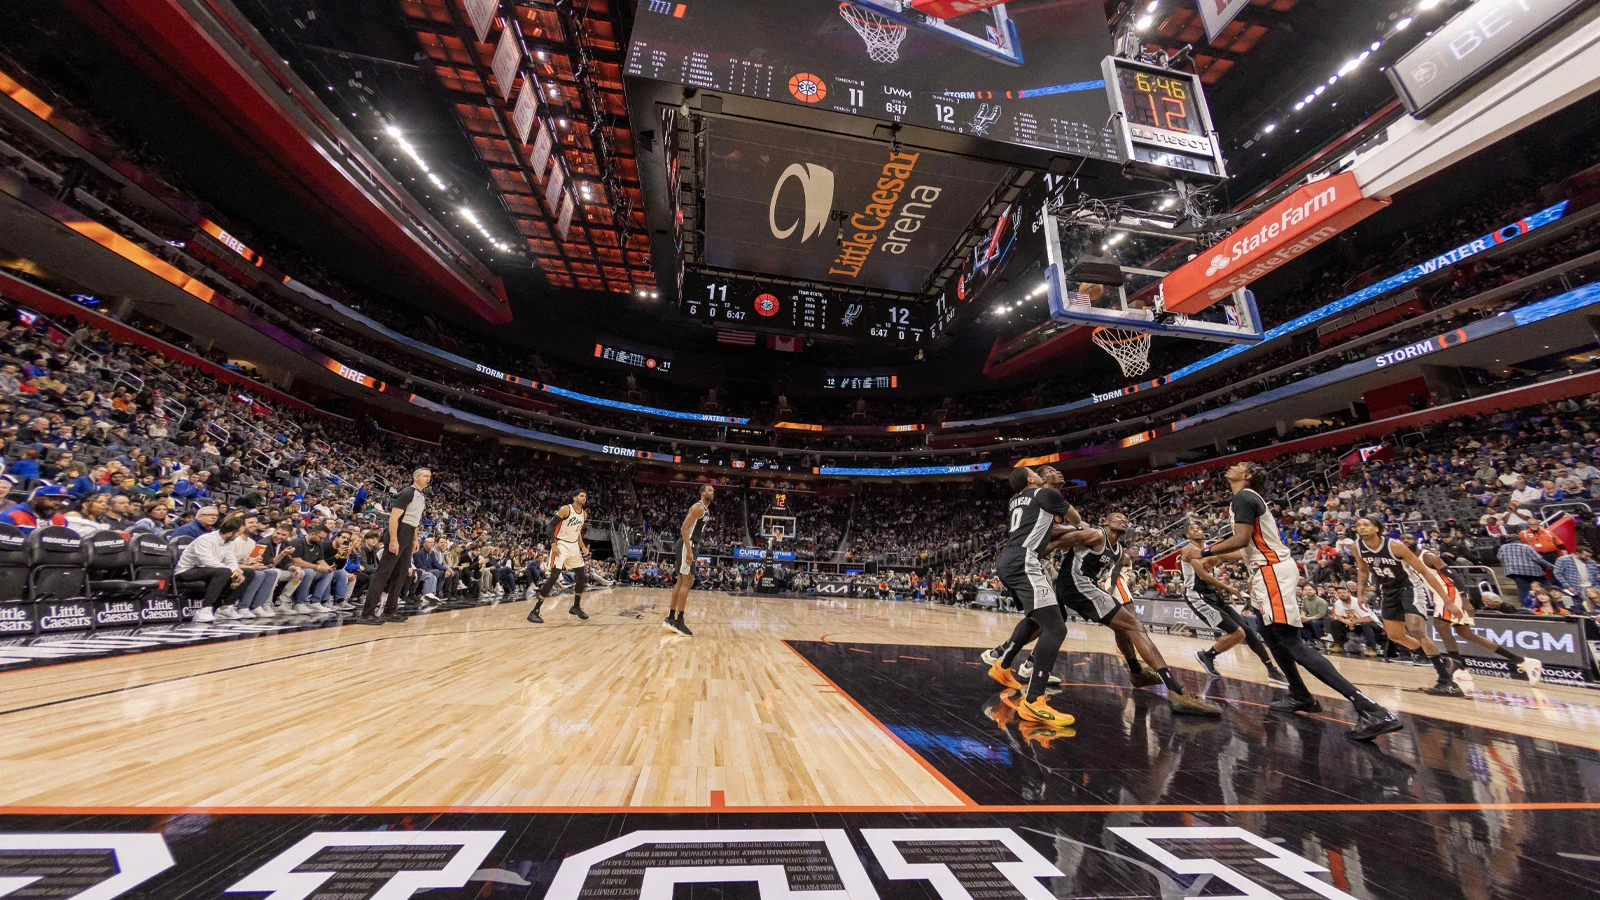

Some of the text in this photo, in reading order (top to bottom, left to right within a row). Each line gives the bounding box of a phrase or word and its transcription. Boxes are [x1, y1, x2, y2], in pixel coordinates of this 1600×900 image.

[883, 85, 912, 99] UWM
[1136, 73, 1186, 99] 6:46
[849, 87, 864, 107] 11
[885, 102, 908, 115] 6:47
[935, 104, 955, 124] 12
[1148, 93, 1190, 133] 12
[1152, 130, 1209, 151] TISSOT
[881, 185, 942, 255] arena
[217, 229, 247, 255] FIRE
[829, 233, 878, 278] Little
[1418, 238, 1488, 275] WATER
[706, 283, 728, 301] 11
[690, 305, 746, 320] 6 0 6:47
[889, 306, 910, 325] 12
[870, 327, 921, 342] 6:47 0 7
[1375, 340, 1434, 368] STORM
[338, 364, 367, 386] FIRE
[475, 363, 504, 380] STORM
[1093, 389, 1123, 404] STORM
[701, 414, 726, 423] WATER
[896, 424, 912, 432] FIRE
[1129, 433, 1145, 445] FIRE
[602, 445, 636, 457] STORM
[948, 465, 971, 473] WATER
[1009, 507, 1024, 533] 0
[49, 604, 85, 619] Little
[104, 601, 134, 613] Little
[147, 599, 174, 611] Little
[97, 611, 140, 623] Caesars
[141, 608, 179, 620] Caesars
[40, 616, 92, 630] Caesars
[1464, 658, 1510, 671] StockX
